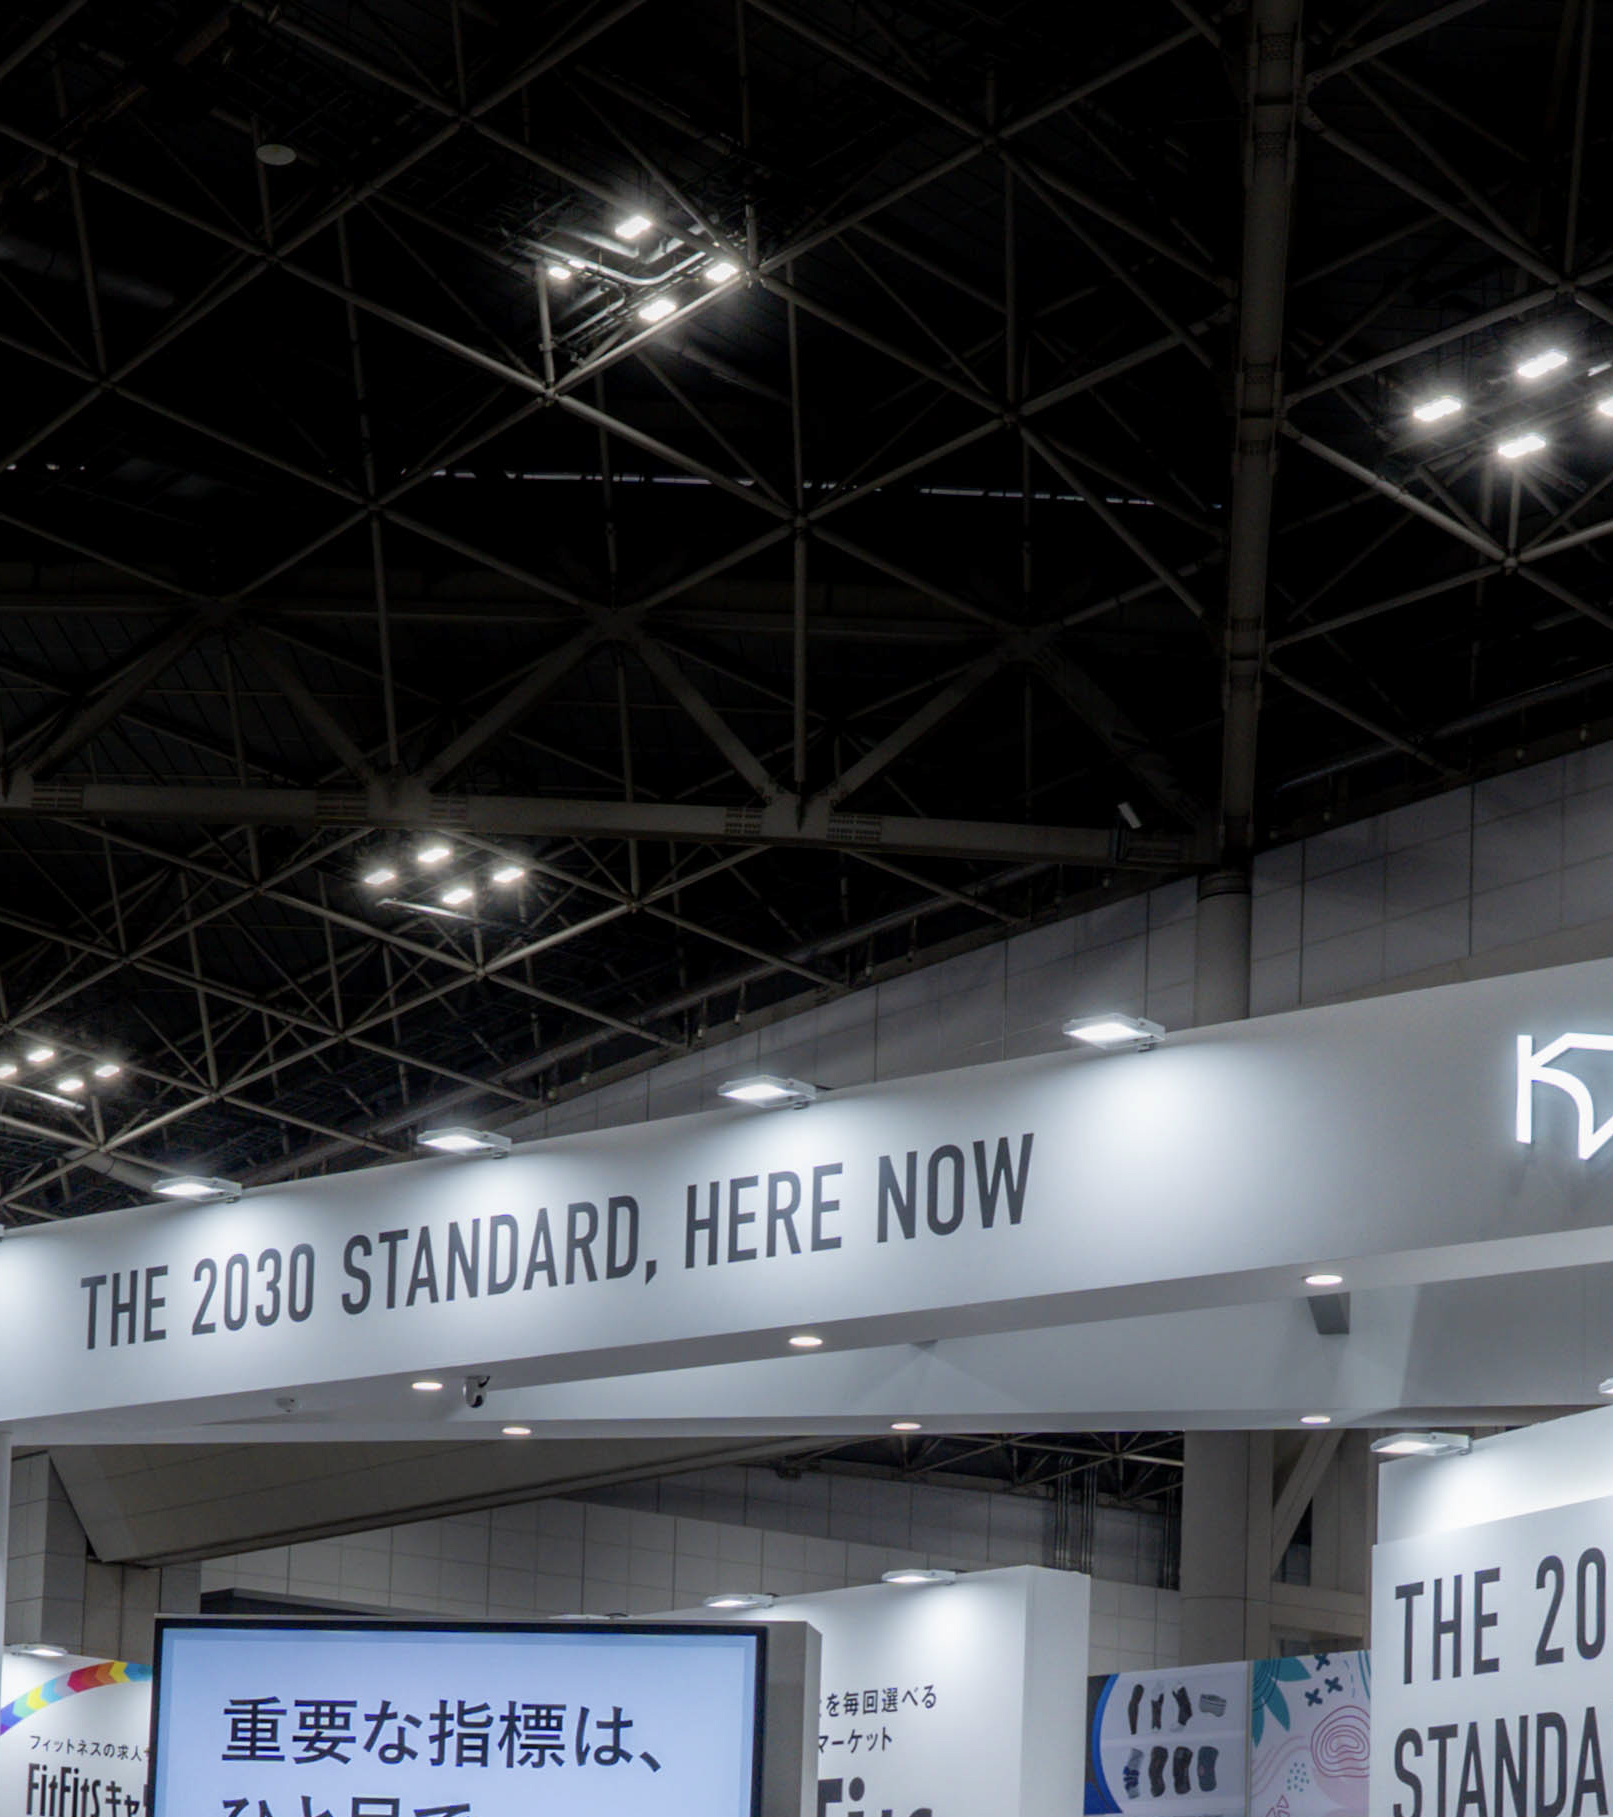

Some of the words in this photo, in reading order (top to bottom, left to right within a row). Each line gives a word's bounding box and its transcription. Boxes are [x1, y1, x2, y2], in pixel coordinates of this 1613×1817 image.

[79, 1264, 169, 1351] THE
[191, 1241, 315, 1336] 2030
[340, 1194, 658, 1316] STANDARD,
[683, 1161, 845, 1270] HERE
[875, 1132, 1036, 1245] NOW
[1394, 1566, 1501, 1685] THE
[220, 1695, 664, 1774] 重要な指標は、
[818, 1684, 938, 1718] を毎回選べる
